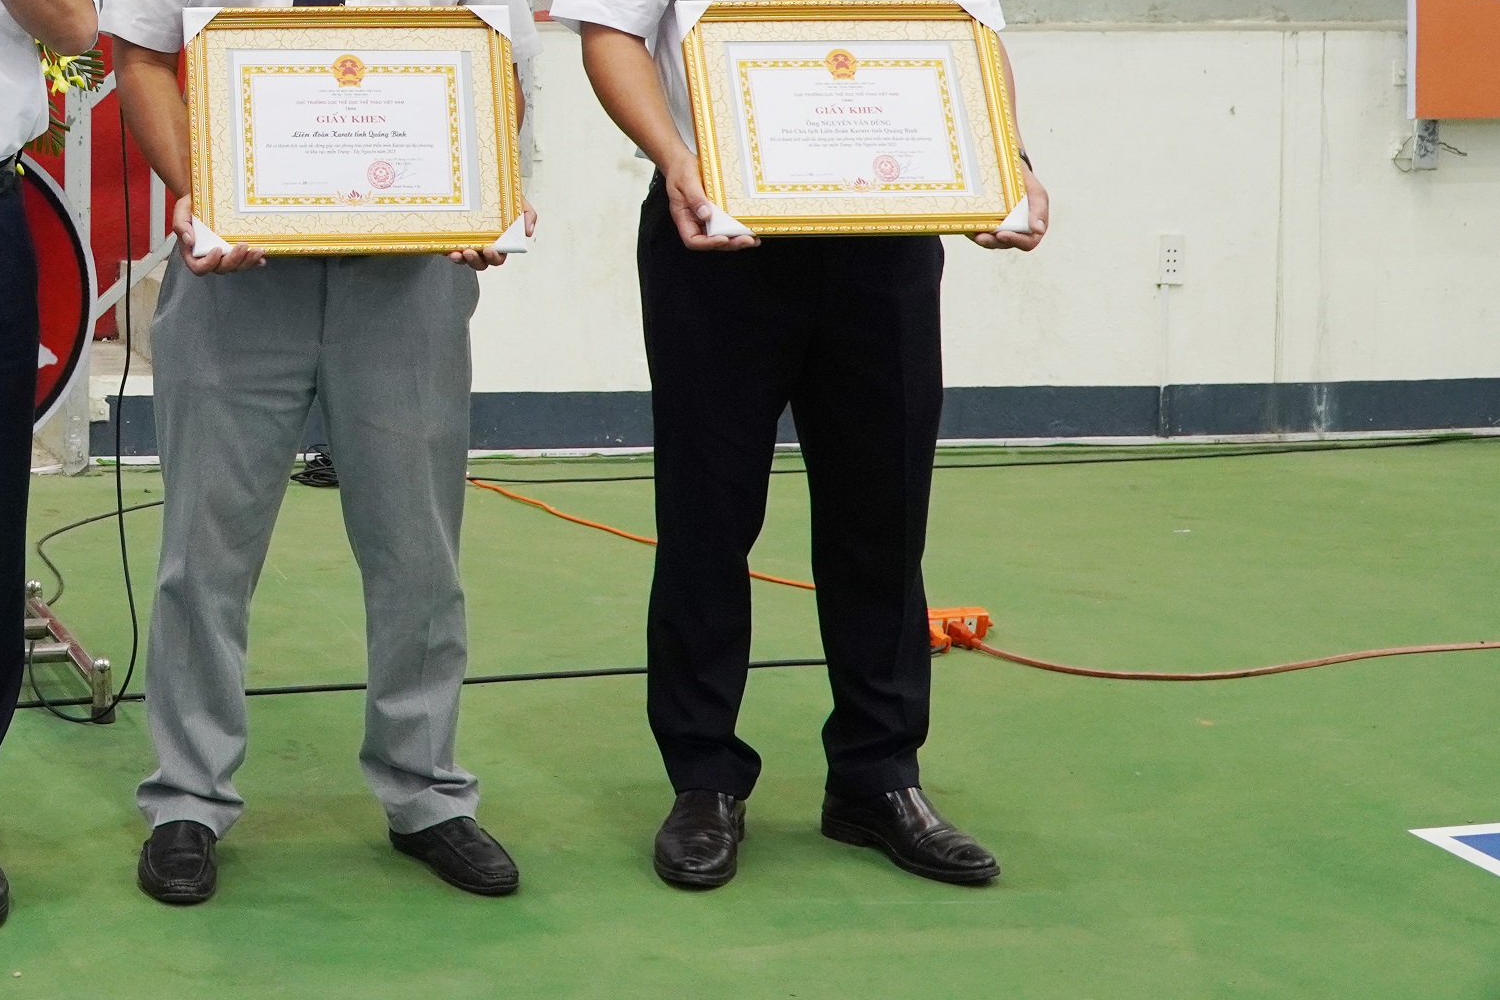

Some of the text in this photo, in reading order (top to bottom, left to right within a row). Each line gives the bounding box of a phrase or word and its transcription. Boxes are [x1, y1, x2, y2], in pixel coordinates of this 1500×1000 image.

[815, 103, 883, 115] GIẤY KHEN
[316, 111, 386, 123] GIẤY KHEN
